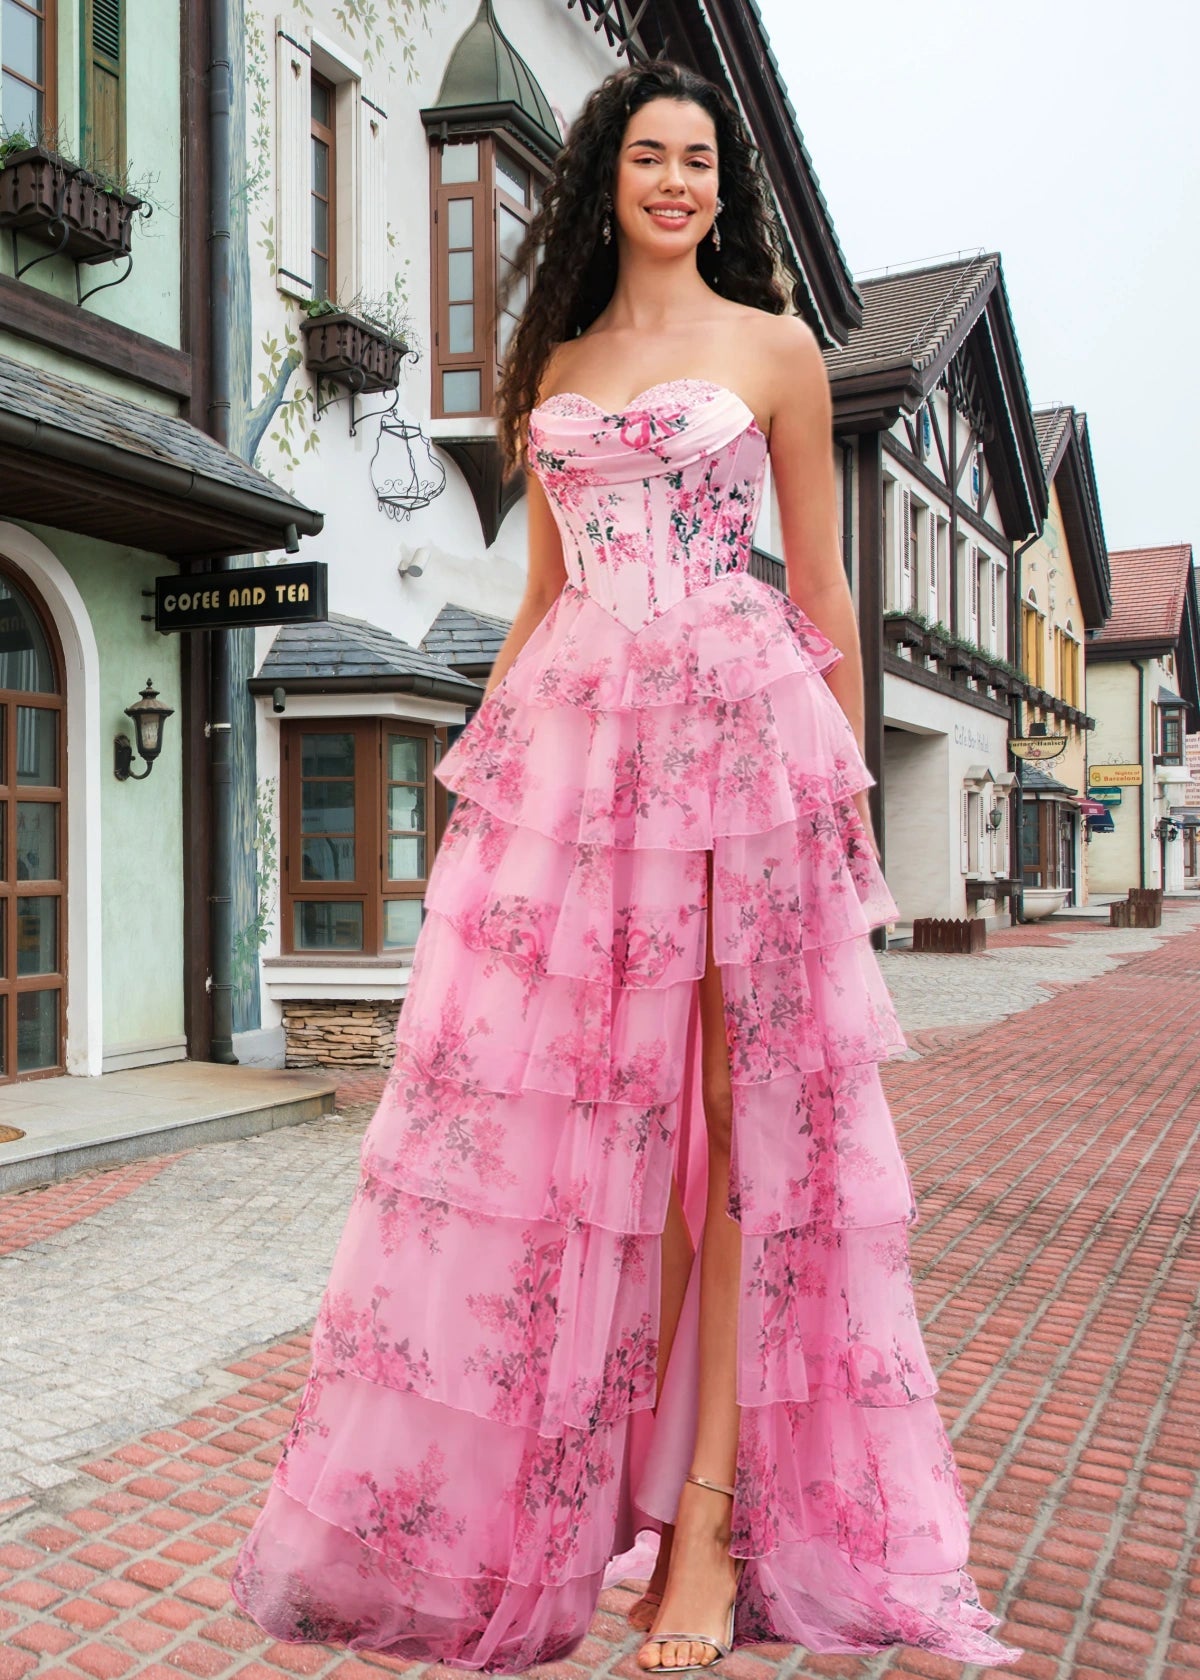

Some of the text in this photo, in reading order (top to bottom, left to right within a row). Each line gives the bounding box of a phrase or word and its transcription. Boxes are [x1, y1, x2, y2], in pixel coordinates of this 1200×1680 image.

[164, 583, 309, 612] COFEE AND TEA
